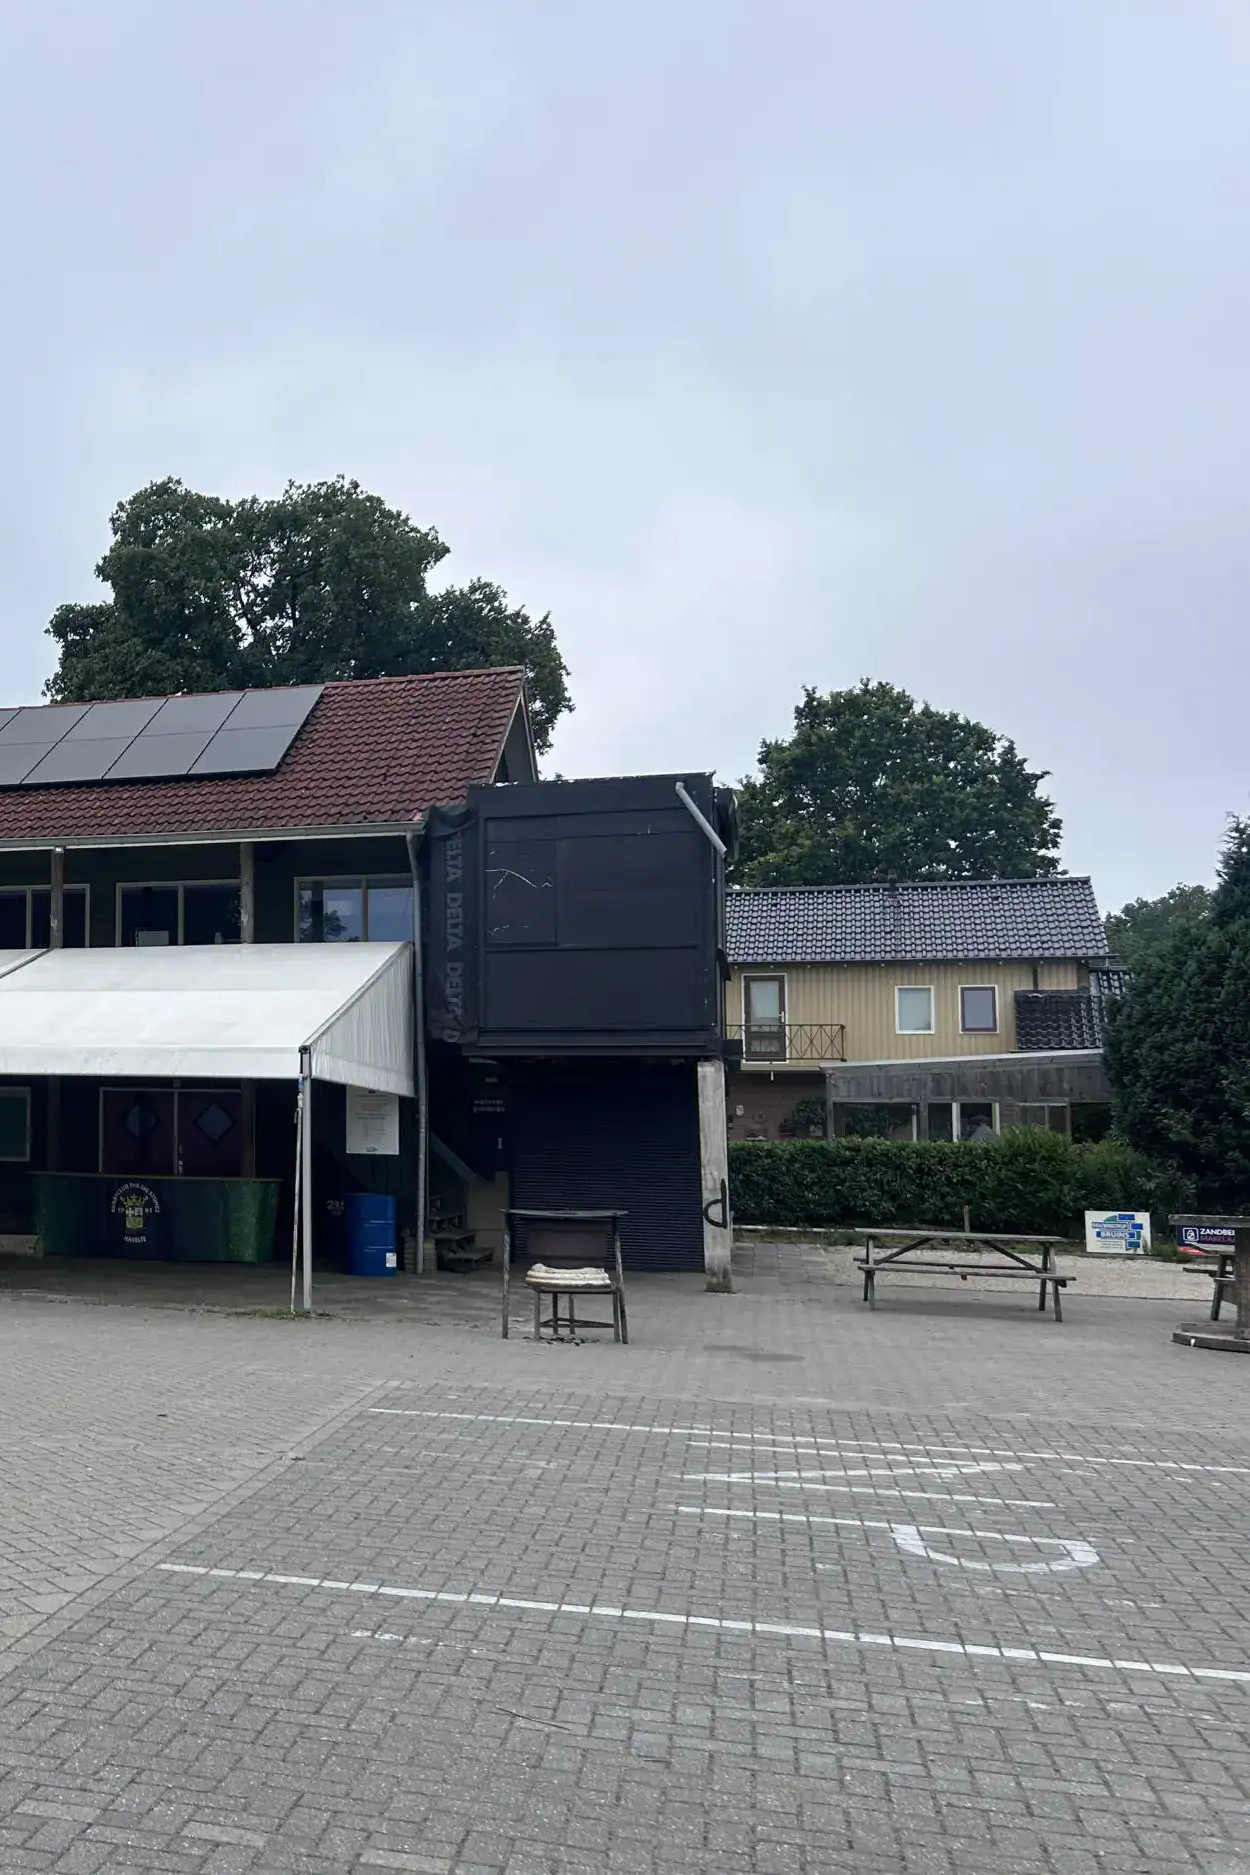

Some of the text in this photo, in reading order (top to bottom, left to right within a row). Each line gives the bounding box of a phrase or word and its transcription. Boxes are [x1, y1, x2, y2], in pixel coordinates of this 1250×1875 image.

[446, 838, 463, 883] ELTA
[446, 892, 464, 952] DELTA
[1100, 1230, 1130, 1239] BRUINS
